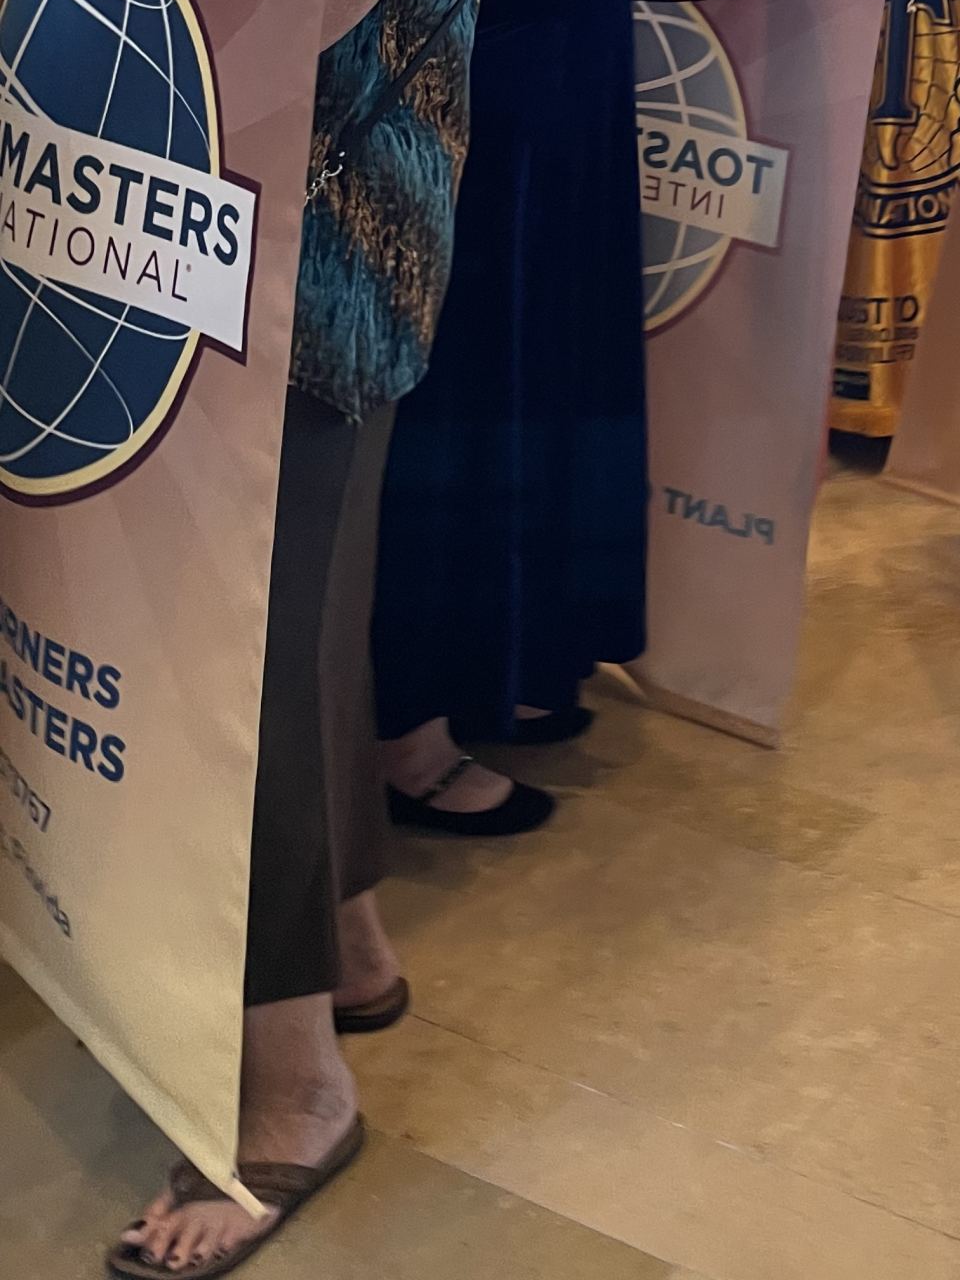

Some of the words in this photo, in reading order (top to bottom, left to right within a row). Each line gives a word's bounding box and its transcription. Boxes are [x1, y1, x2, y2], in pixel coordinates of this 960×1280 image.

[0, 121, 241, 266] MASTERS
[0, 192, 188, 302] ATIONAL
[0, 596, 122, 710] RNERS
